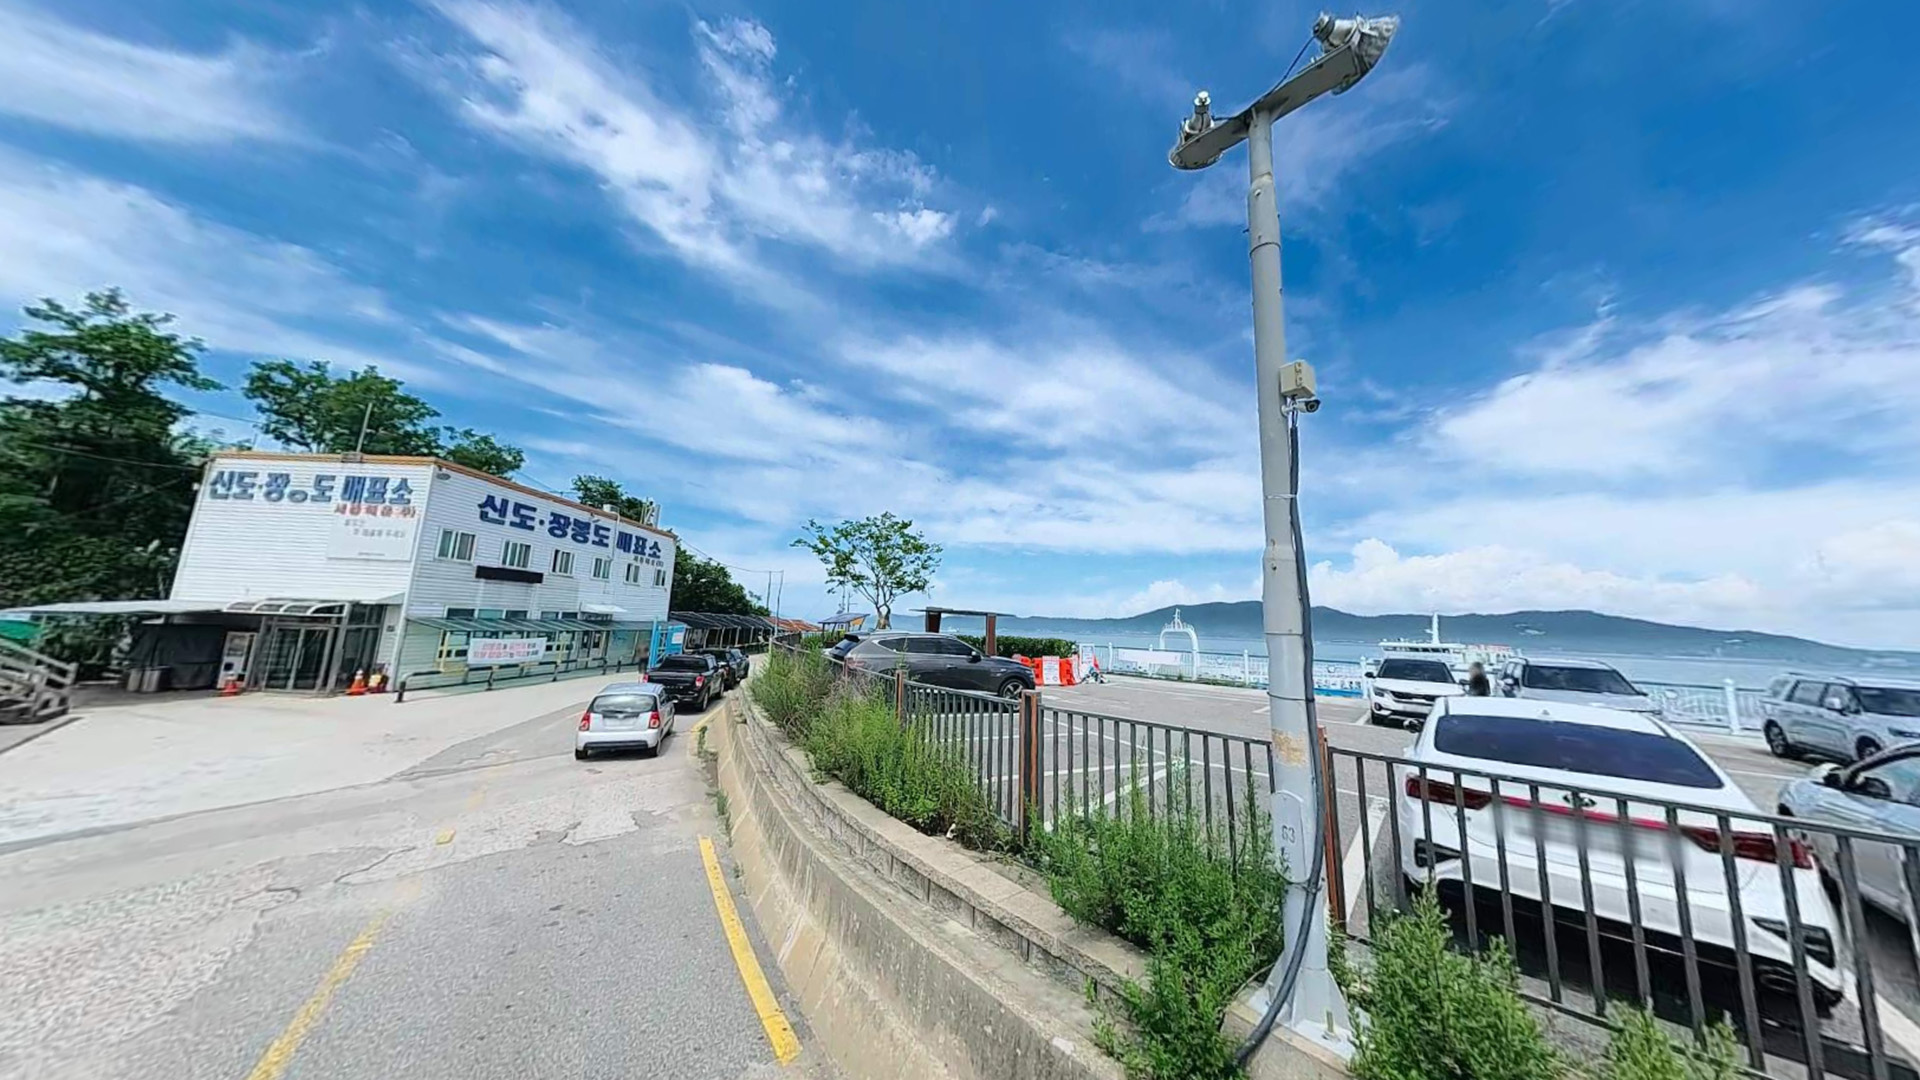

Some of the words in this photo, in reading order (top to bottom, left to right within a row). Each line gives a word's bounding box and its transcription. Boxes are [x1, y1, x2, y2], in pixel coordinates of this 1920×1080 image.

[341, 475, 414, 505] 매표소
[478, 494, 611, 548] 신도·장봉도
[616, 531, 662, 559] 매표소
